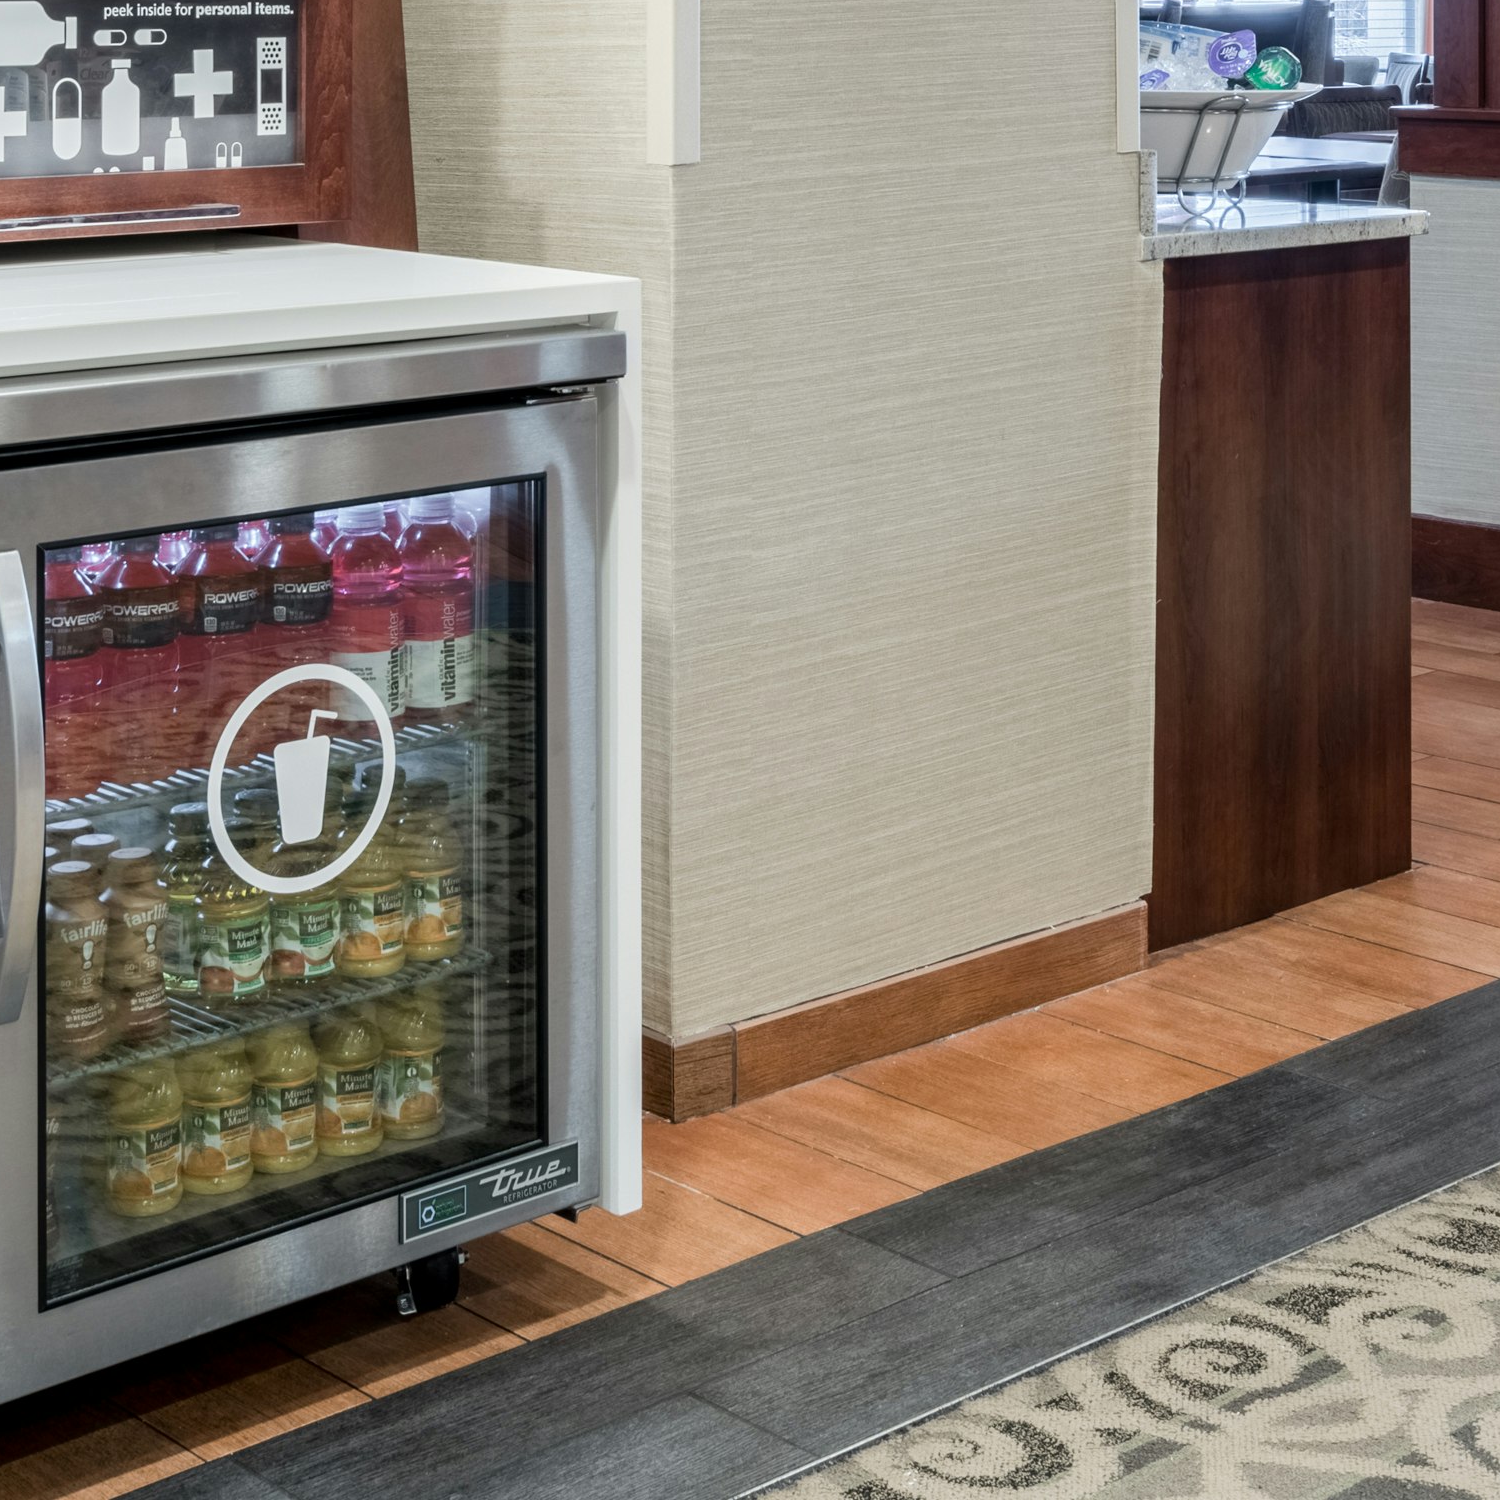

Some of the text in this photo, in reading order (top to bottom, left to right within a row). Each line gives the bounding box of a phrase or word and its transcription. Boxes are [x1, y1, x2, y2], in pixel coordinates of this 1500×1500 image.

[103, 1, 295, 20] peek inside for personal items.
[103, 600, 180, 617] POWERADE
[377, 890, 402, 906] Minut
[302, 910, 331, 925] Minute
[231, 926, 261, 942] Minute
[307, 921, 329, 934] Maid
[236, 937, 258, 950] Maid
[340, 1073, 373, 1085] Minute
[284, 1086, 316, 1100] Minute
[344, 1081, 369, 1092] Maid
[288, 1095, 311, 1108] Maid
[227, 1114, 250, 1128] Maid
[150, 1126, 178, 1143] Minute
[154, 1136, 174, 1150] Maid
[478, 1159, 567, 1198] true
[503, 1179, 558, 1204] REFRIGERATOR
